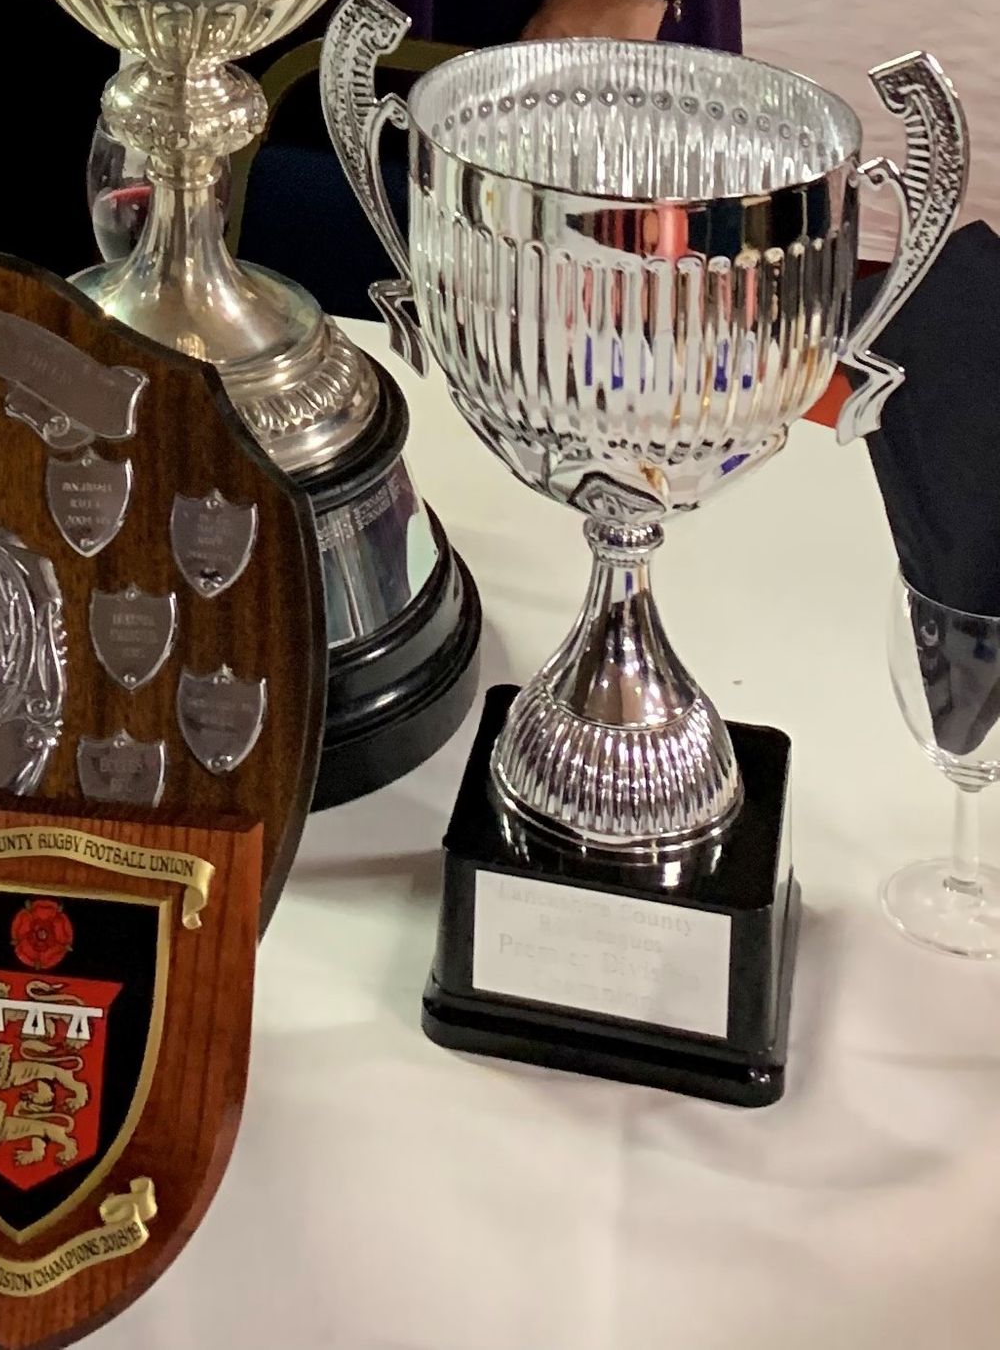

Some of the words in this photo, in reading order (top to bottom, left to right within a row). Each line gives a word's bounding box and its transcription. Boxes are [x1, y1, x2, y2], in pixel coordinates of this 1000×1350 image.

[38, 833, 81, 853] RUGBY
[85, 840, 147, 870] FOOTBALL
[150, 854, 195, 878] UNION
[34, 1239, 101, 1287] CHAMPIONS
